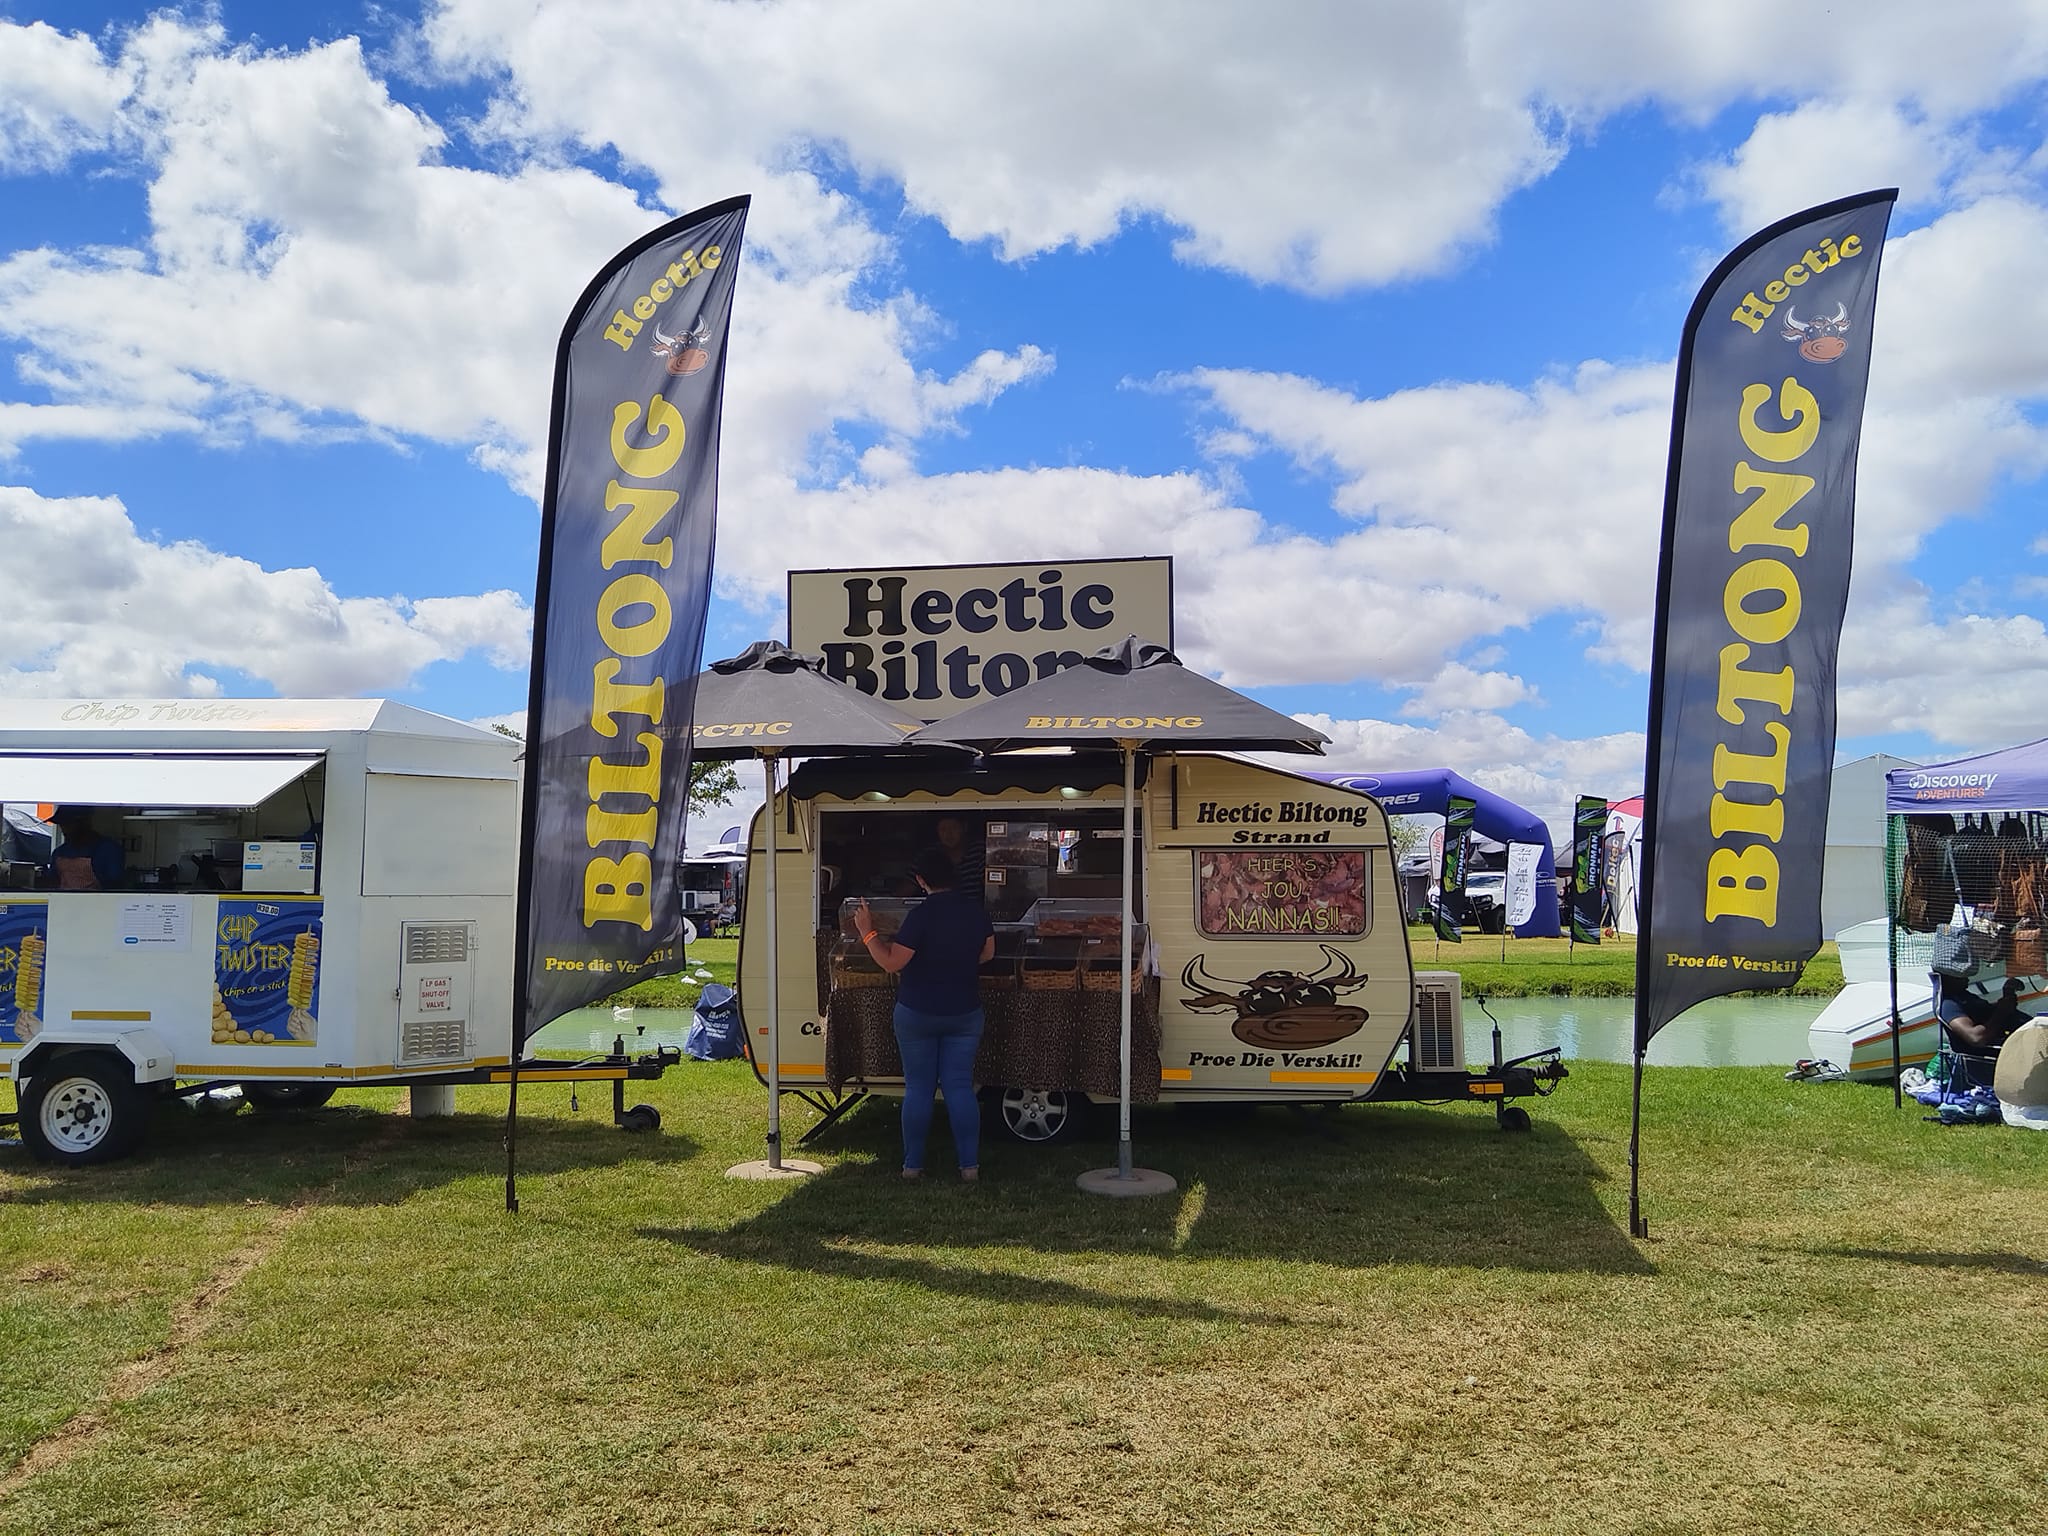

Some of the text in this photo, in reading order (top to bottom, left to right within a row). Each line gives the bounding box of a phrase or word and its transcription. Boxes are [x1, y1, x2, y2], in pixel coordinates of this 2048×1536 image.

[1731, 234, 1863, 334] Hectic
[603, 245, 721, 351] Hectic
[843, 570, 1114, 636] Hectic
[583, 394, 685, 931] BILTONG
[1706, 377, 1820, 928] BILTONG
[61, 702, 268, 726] Chip Twister
[1025, 716, 1204, 729] BILTONG
[692, 721, 792, 738] ECTIC
[1909, 773, 1998, 790] Discovery
[1916, 787, 1985, 800] ADVENTURES
[1196, 801, 1369, 827] Hectic Biltong
[1232, 830, 1331, 844] Strand
[1456, 834, 1466, 886] IRONMAN
[1588, 834, 1599, 886] IRONMAN
[1261, 881, 1302, 899] JOU
[218, 914, 259, 943] CHIP
[1227, 907, 1339, 931] NANNAS!!
[217, 941, 290, 973] TWISTER
[545, 957, 584, 971] Proe
[587, 959, 612, 972] die
[1666, 953, 1703, 968] Proe
[1706, 955, 1728, 968] die
[224, 987, 245, 999] Chips
[421, 990, 449, 998] SHUT-OFF
[1188, 1052, 1362, 1068] Proe Die Verskil!
